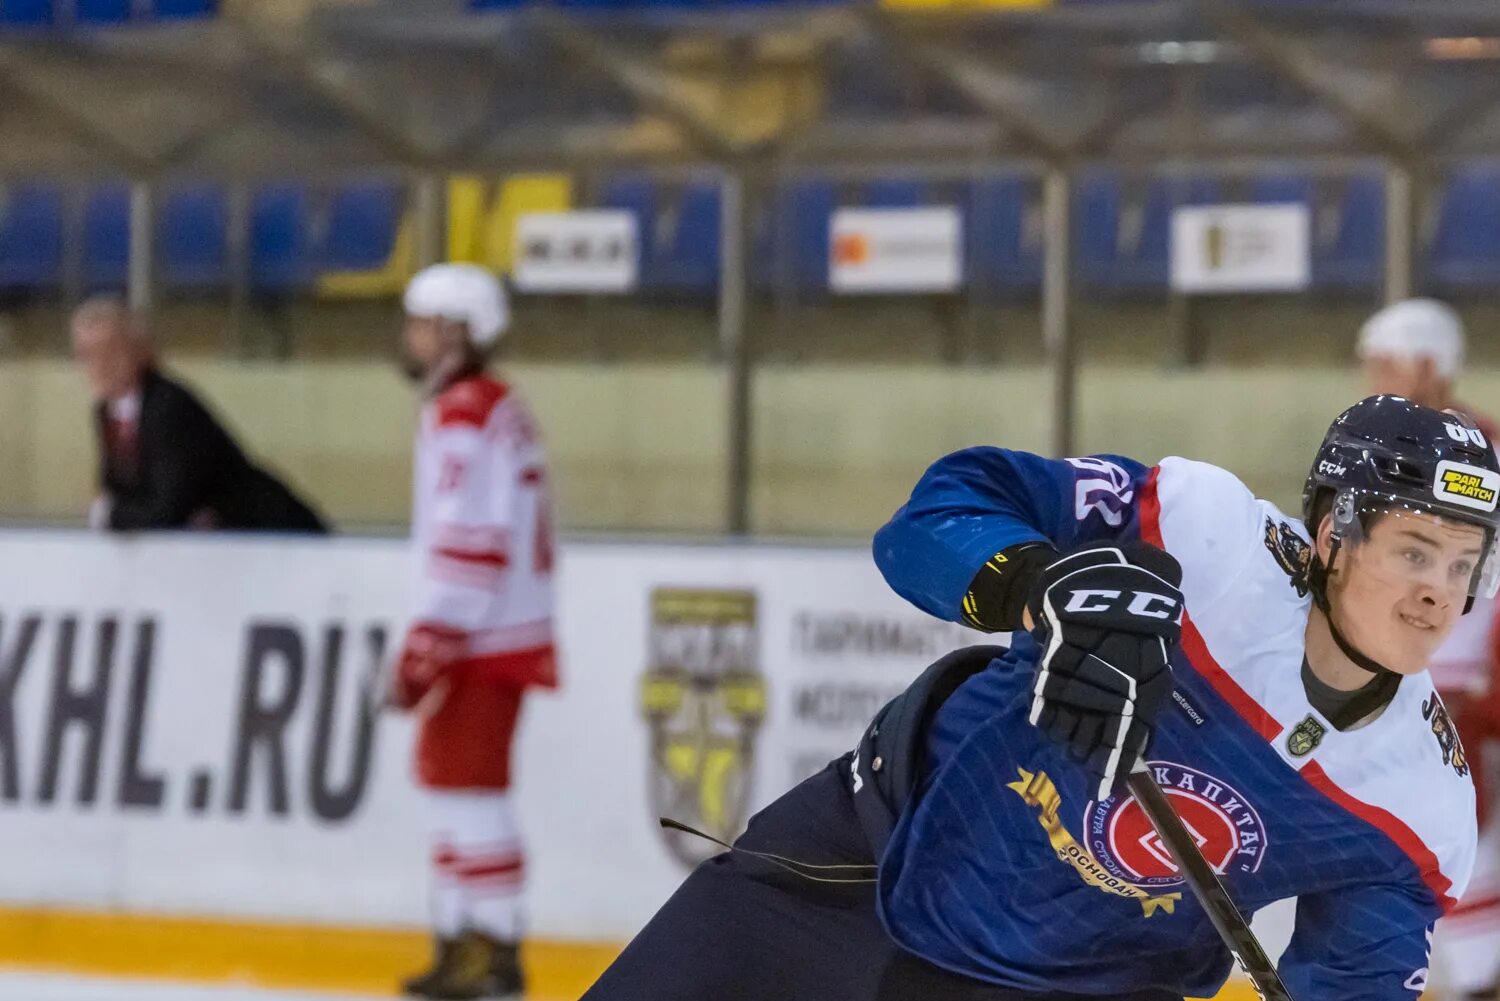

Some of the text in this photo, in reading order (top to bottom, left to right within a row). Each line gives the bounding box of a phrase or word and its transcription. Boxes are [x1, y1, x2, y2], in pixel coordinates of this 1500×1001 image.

[1318, 460, 1347, 476] CCM
[1444, 471, 1481, 488] PARI
[1447, 482, 1493, 501] MATCH
[1064, 589, 1184, 627] CC
[1172, 690, 1204, 725] astercard
[1068, 846, 1138, 897] ОСНОВАН
